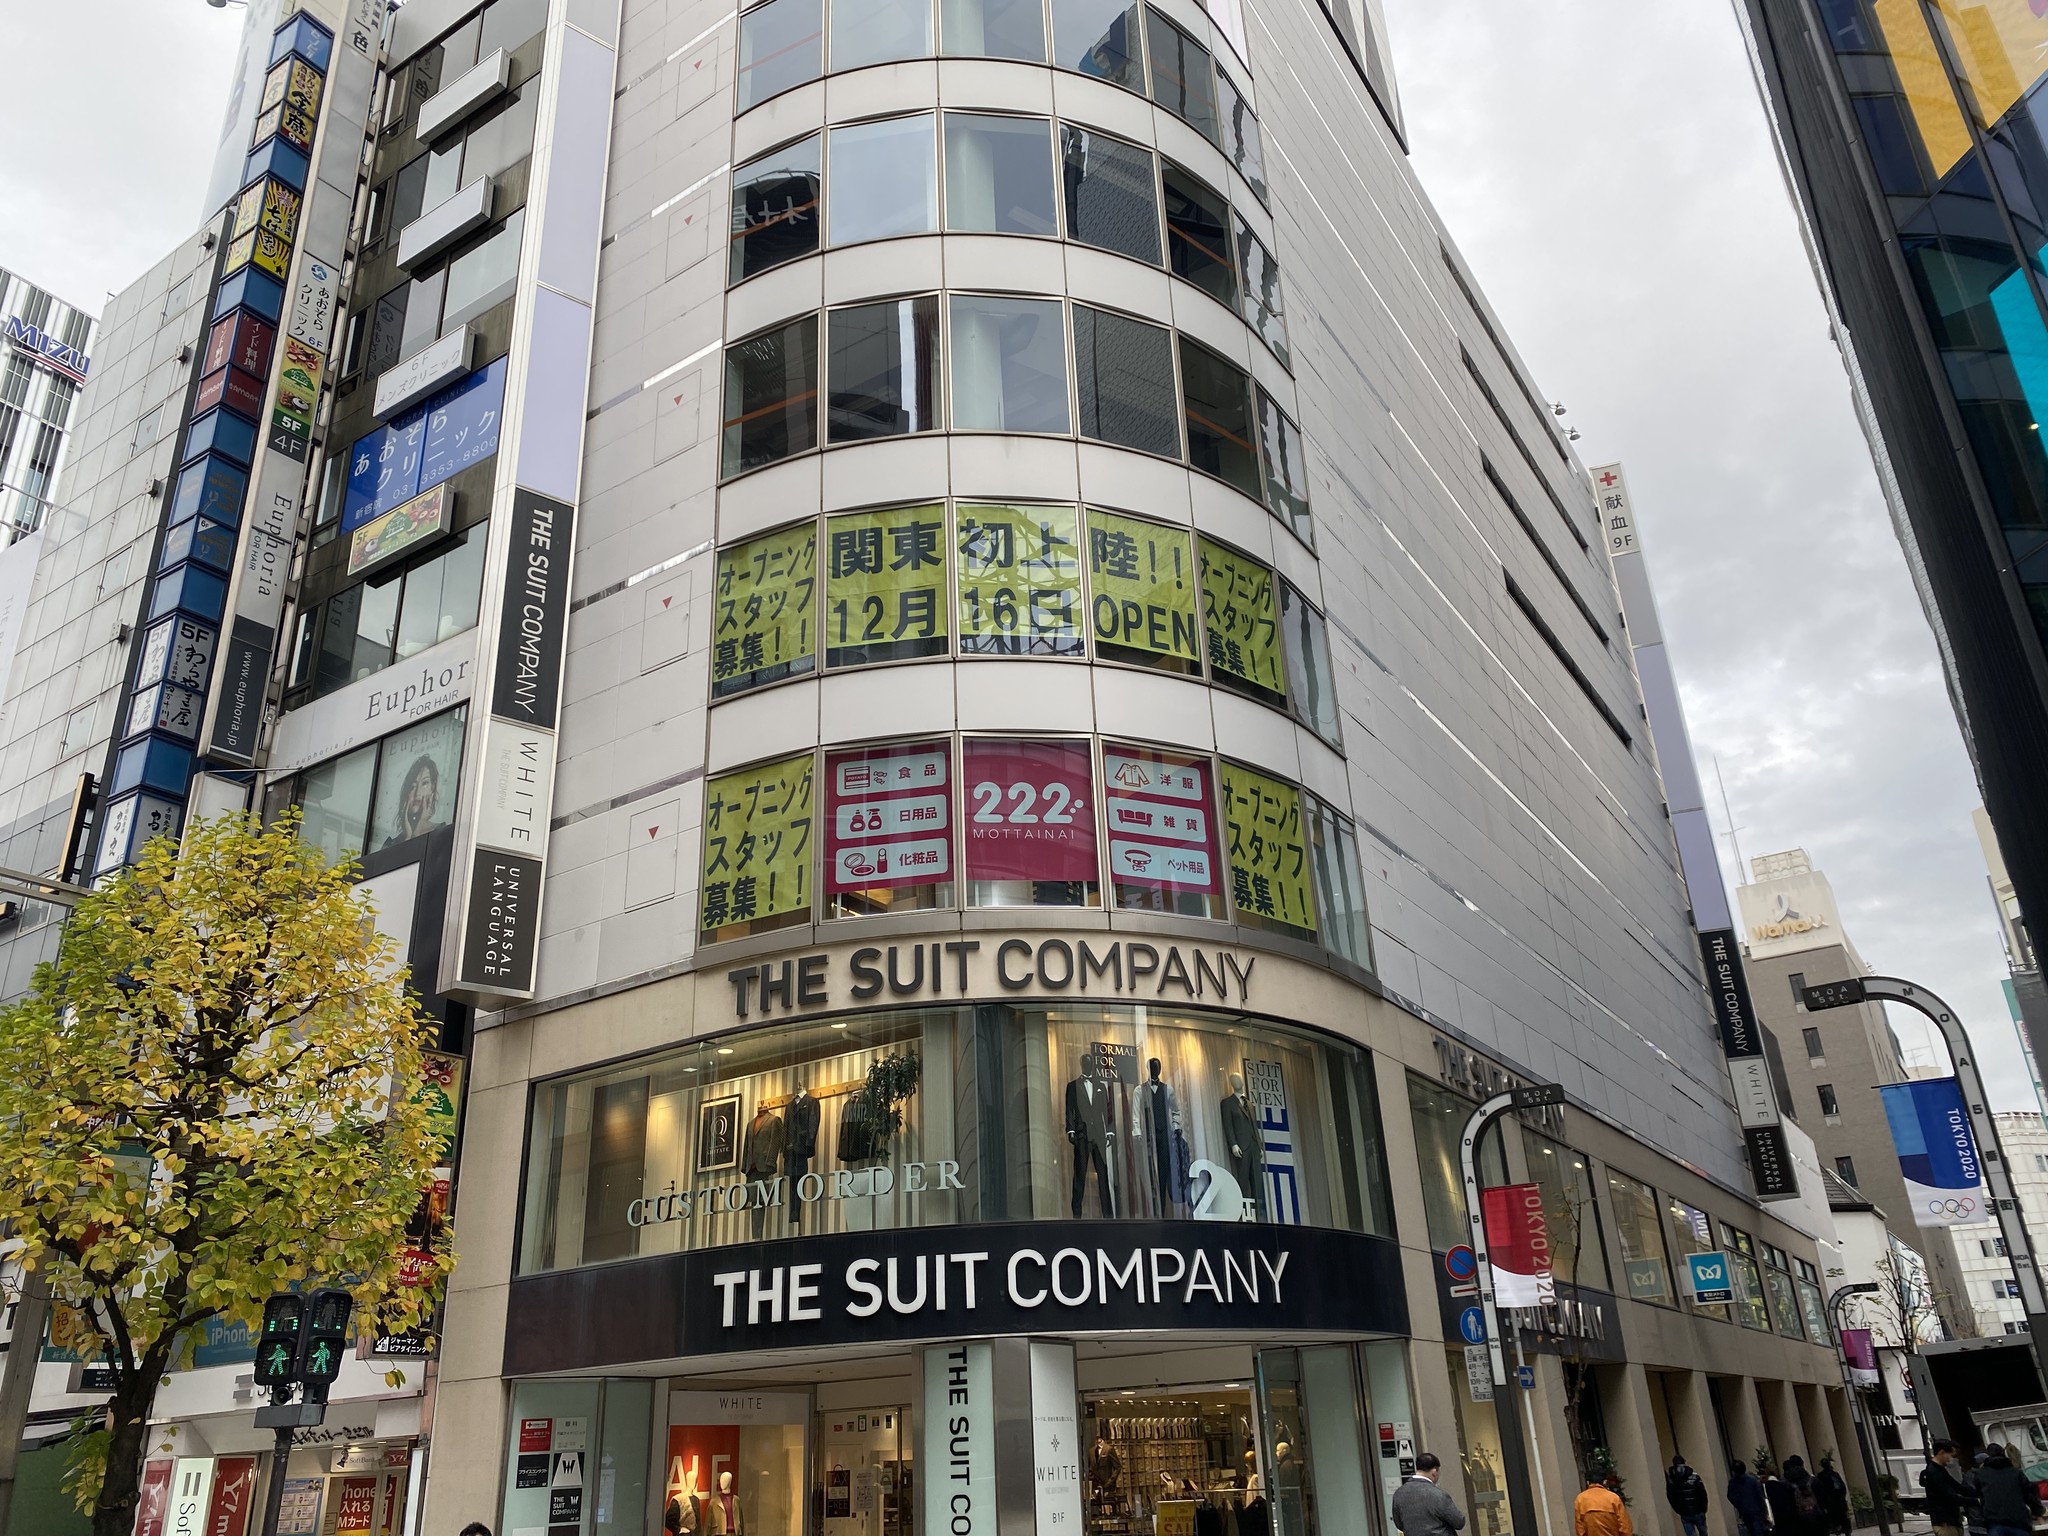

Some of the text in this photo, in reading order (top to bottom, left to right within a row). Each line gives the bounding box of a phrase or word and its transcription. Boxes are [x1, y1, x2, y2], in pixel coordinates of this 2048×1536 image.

[293, 283, 313, 336] クリニック
[313, 287, 330, 331] あおぞら
[3, 314, 92, 376] MIZU
[243, 322, 260, 371] インド料理
[308, 336, 324, 349] 6F
[411, 351, 430, 371] 6F
[377, 349, 461, 408] メンズクリニック
[274, 434, 303, 453] 4F
[280, 414, 302, 433] 5F
[354, 409, 448, 477] あおぞら
[354, 435, 498, 521] 新宿院 03-3353-8800
[376, 410, 496, 492] クリニック
[356, 530, 369, 546] 5F
[1604, 494, 1629, 531] 献血
[258, 492, 293, 597] Euphoria
[718, 532, 817, 597] オープニング
[1613, 535, 1633, 548] 9F
[718, 576, 815, 635] スタッフ
[1199, 551, 1274, 614] オープニング
[180, 622, 210, 642] 5F
[513, 506, 555, 715] THE SUIT COMPANY
[1092, 593, 1196, 656] OPEN
[1202, 585, 1276, 647] スタッフ
[228, 650, 252, 746] www.euphoria.jp
[364, 659, 470, 721] Euphor
[409, 689, 459, 718] FOR HAIR
[510, 742, 539, 842] WHITE
[708, 765, 814, 831] オープニング
[898, 763, 937, 779] 食品
[1159, 774, 1195, 790] 洋服
[899, 807, 938, 822] 日用品
[972, 828, 1077, 840] MOTTAINAI
[1163, 815, 1199, 832] 雑貨
[1220, 778, 1301, 838] オープニング
[706, 818, 814, 876] スタッフ
[898, 850, 939, 867] 化粧品
[1167, 859, 1205, 875] ペット用品
[1229, 826, 1304, 880] スタッフ
[483, 863, 506, 976] LANGUAGE
[499, 866, 521, 977] UNIVERSAL
[728, 938, 1258, 1018] THE SUIT COMPANY
[1711, 936, 1750, 1054] THE SUIT COMPANY
[1094, 1043, 1137, 1057] FORMAL
[1094, 1056, 1115, 1067] FOR
[1095, 1068, 1119, 1079] MEN
[1247, 1062, 1281, 1078] SUIT
[1251, 1091, 1284, 1108] MEN
[1252, 1078, 1280, 1092] FOR
[1746, 1063, 1770, 1120] WHITE
[1755, 1132, 1776, 1191] LANGUAGE
[1764, 1131, 1783, 1190] UNIVERSAL
[1947, 1108, 1978, 1180] TOKYO 2020
[626, 1159, 967, 1229] CUSTOM ORDER
[1523, 1183, 1557, 1306] TOKYO 2020
[713, 1247, 1290, 1329] THE SUIT COMPANY
[719, 1396, 763, 1410] WHITE
[948, 1346, 968, 1406] THE
[949, 1414, 970, 1488] SUIT
[1036, 1465, 1077, 1481] WHITE
[220, 1472, 246, 1514] Y!
[340, 1500, 371, 1514] 入れる
[552, 1508, 579, 1516] COMPANY
[1052, 1512, 1065, 1524] B1F
